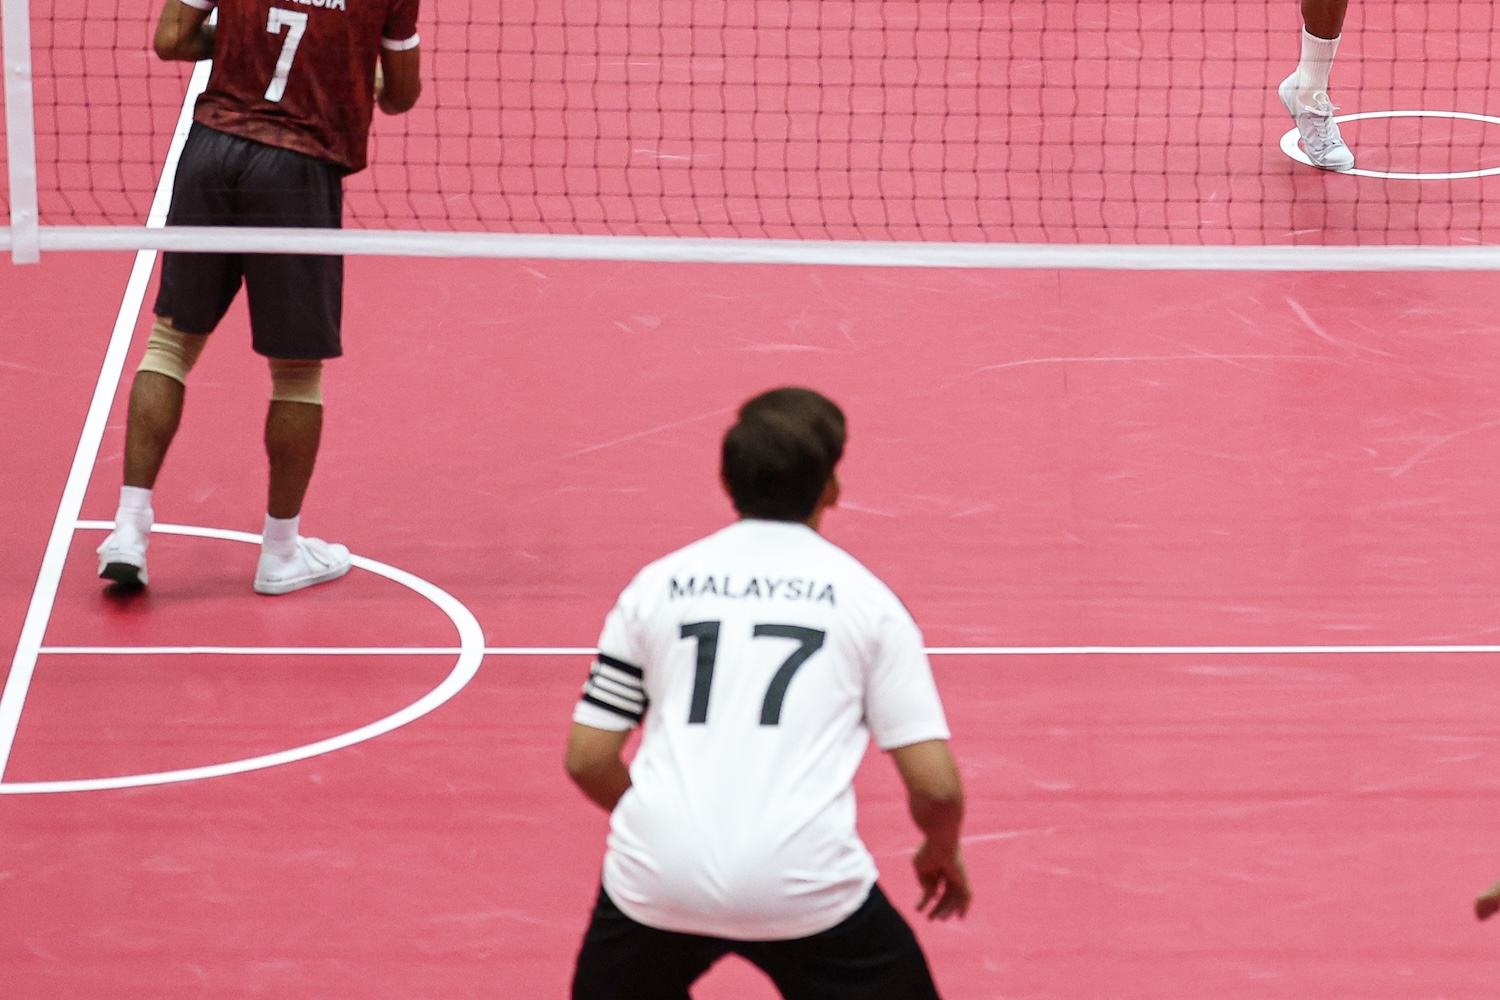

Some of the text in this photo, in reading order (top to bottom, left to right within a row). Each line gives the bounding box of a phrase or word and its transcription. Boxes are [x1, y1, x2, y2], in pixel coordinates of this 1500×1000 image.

[264, 6, 309, 103] 7
[669, 574, 837, 606] MALAYSIA
[680, 621, 826, 726] 17
